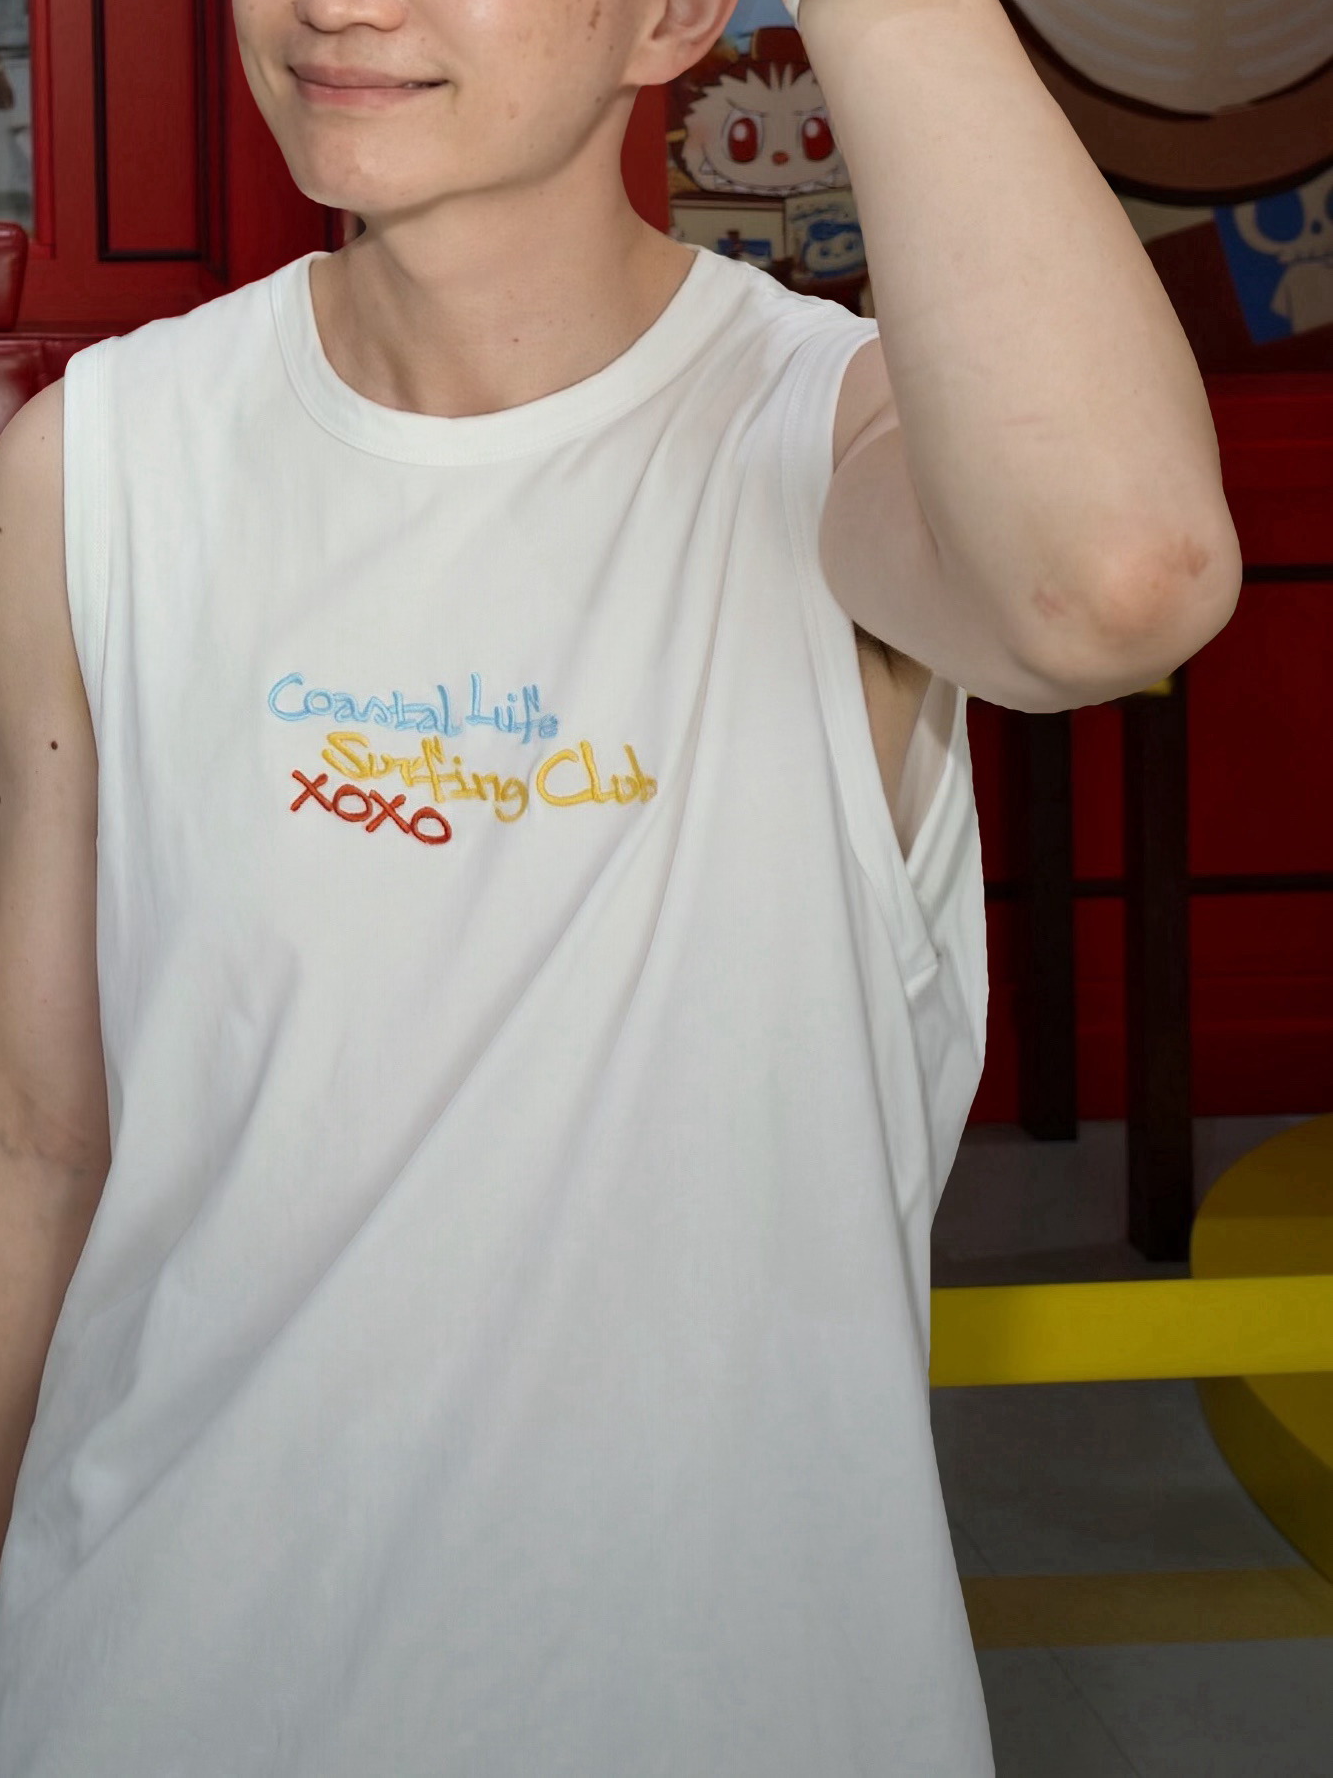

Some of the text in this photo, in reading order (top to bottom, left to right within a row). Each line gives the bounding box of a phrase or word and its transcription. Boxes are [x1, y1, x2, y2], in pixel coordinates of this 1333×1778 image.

[267, 672, 463, 738] Coastal
[320, 731, 660, 824] Surfing Club
